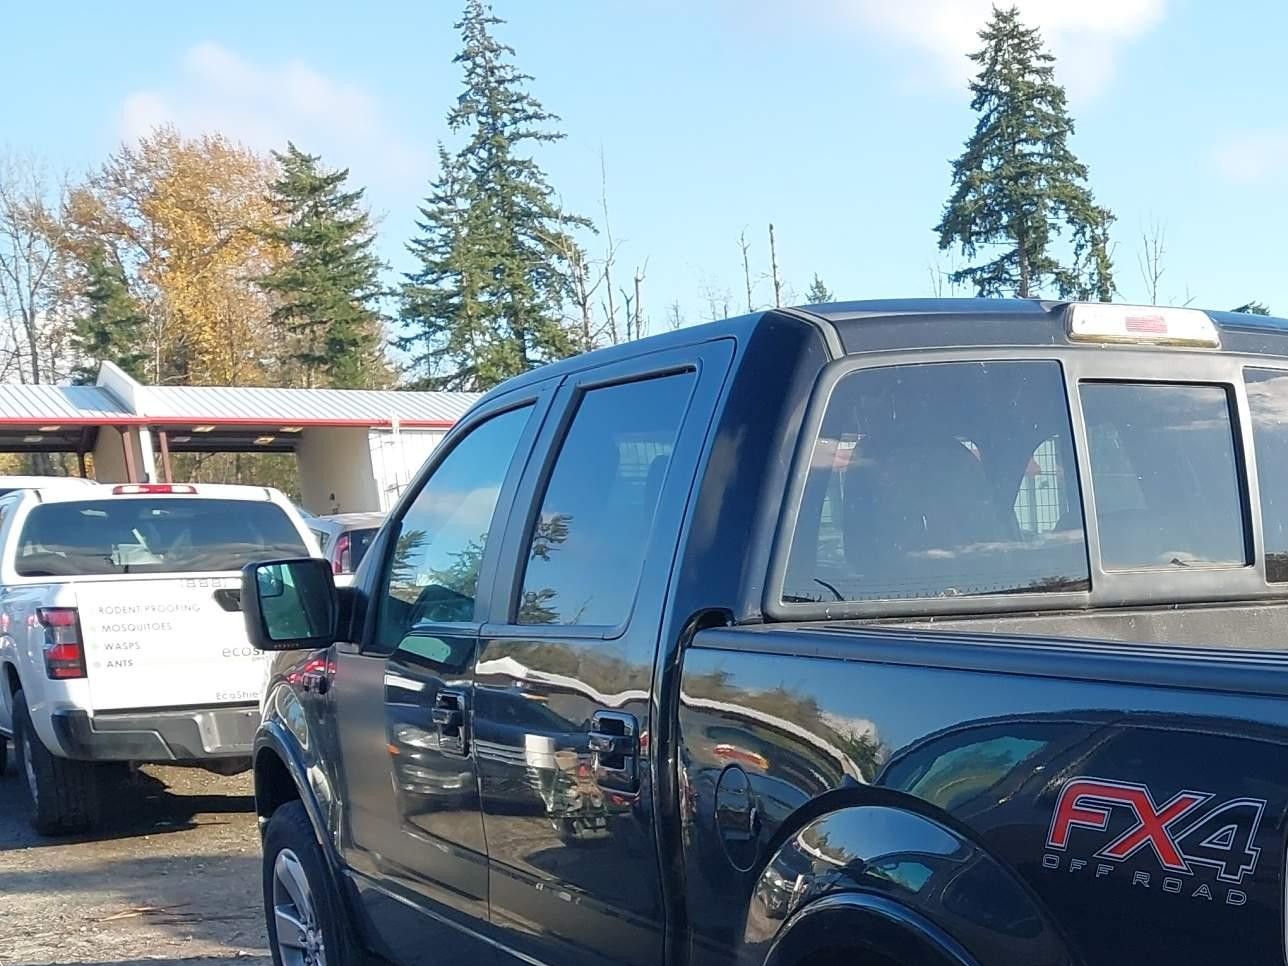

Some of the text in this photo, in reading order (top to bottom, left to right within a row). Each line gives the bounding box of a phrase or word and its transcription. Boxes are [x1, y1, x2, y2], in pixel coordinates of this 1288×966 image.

[98, 603, 201, 615] RODENT PROOFING
[102, 622, 172, 632] MOSQUITOES
[104, 641, 141, 650] WASPS
[106, 659, 134, 668] ANTS
[1045, 776, 1267, 885] FX4
[1042, 853, 1247, 906] OFF ROAD
